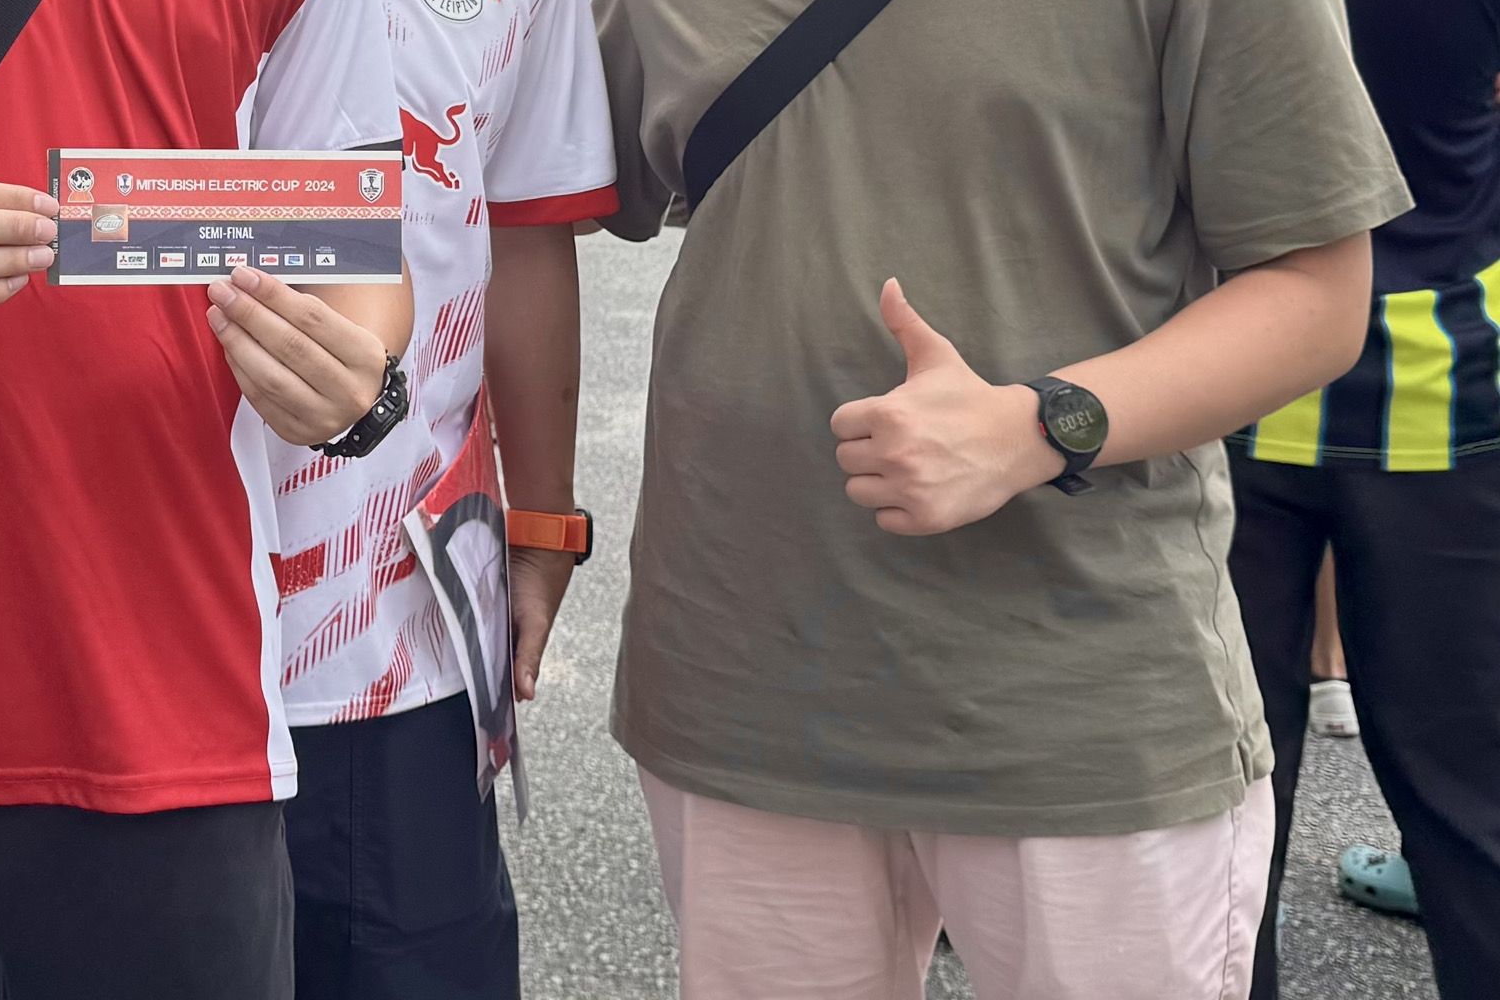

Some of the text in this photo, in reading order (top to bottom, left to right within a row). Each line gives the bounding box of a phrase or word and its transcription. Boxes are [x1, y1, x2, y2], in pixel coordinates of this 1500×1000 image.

[136, 179, 336, 192] MITSUBISHI ELECTRIC CUP 2024
[199, 226, 255, 239] SEMI-FINAL
